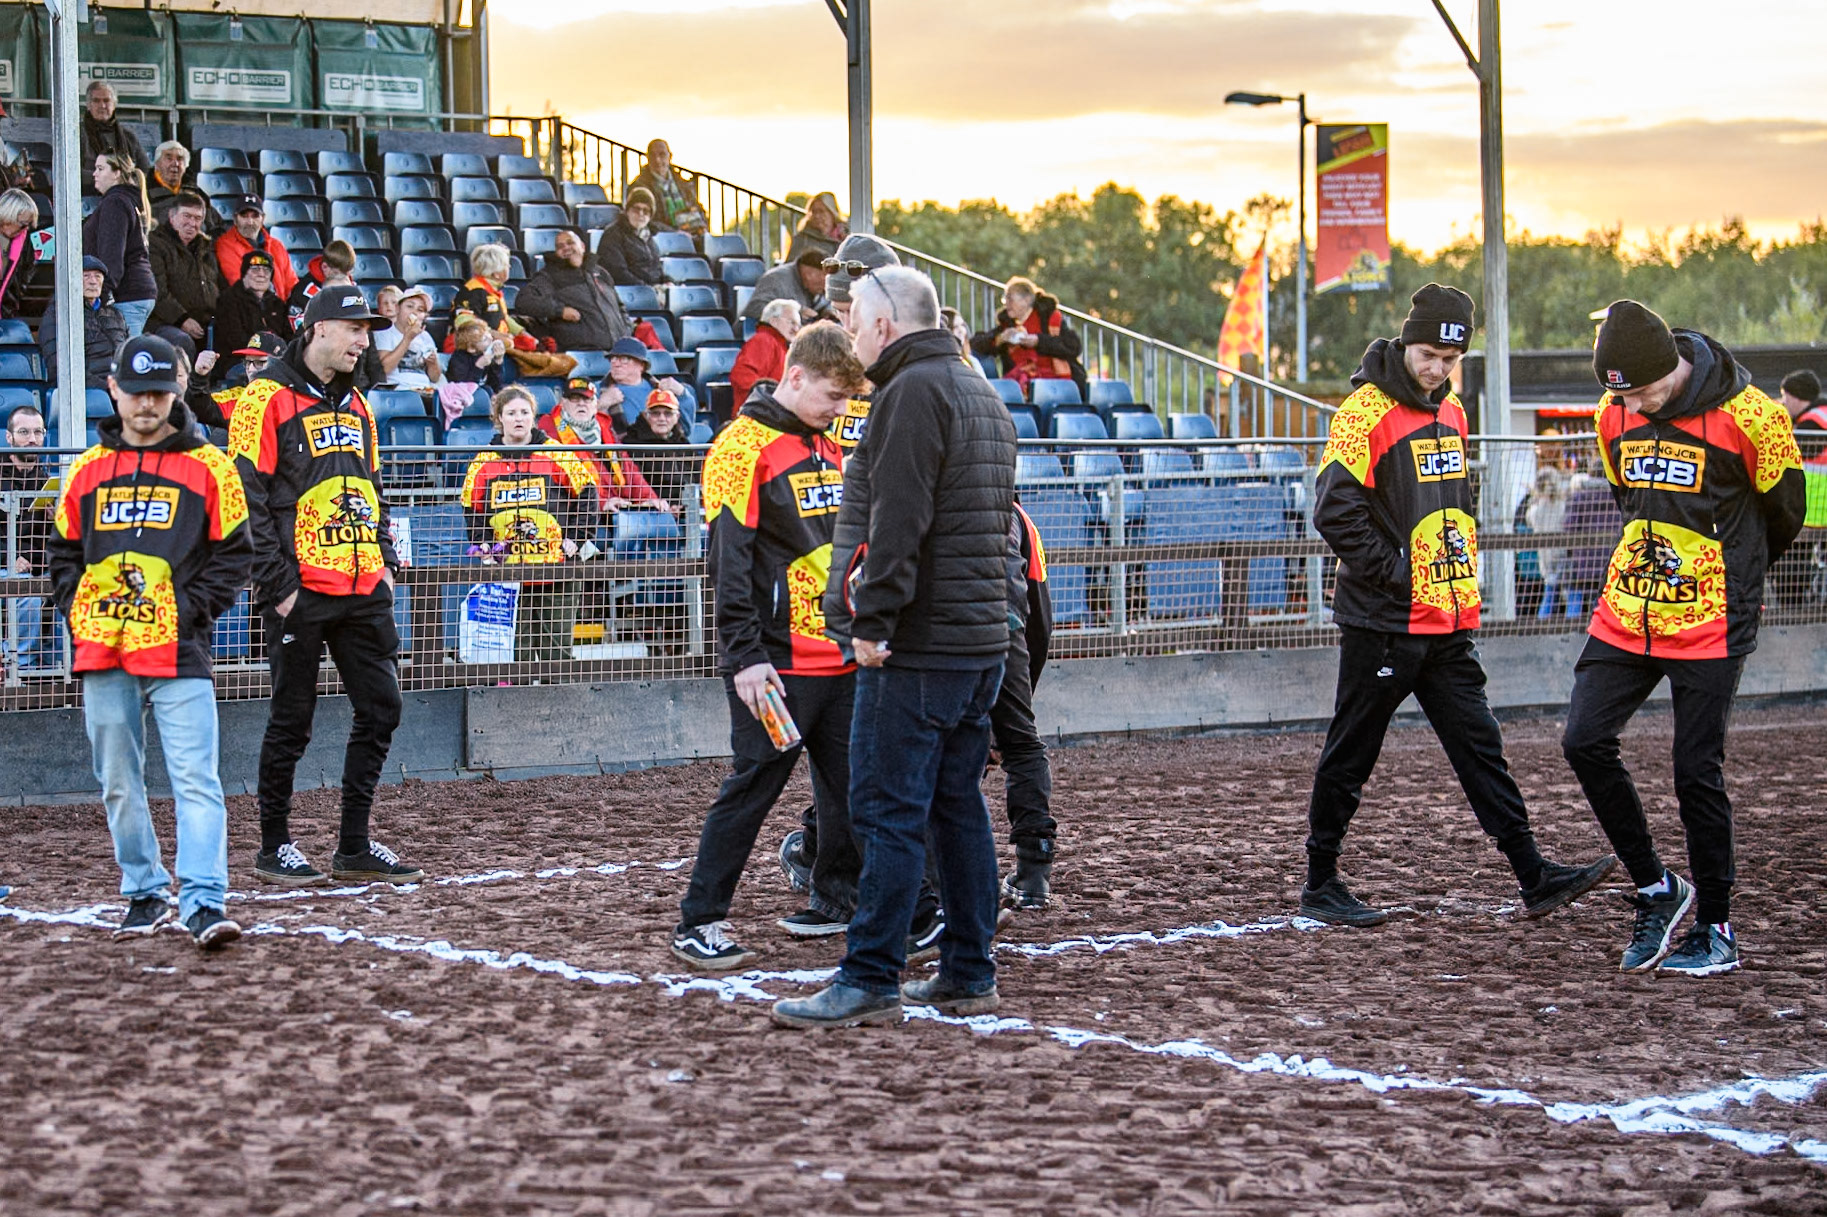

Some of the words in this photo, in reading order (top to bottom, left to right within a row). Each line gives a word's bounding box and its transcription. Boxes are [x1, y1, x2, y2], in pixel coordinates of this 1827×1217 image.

[107, 67, 153, 78] BARRIER
[194, 71, 241, 85] ECHO
[242, 74, 285, 87] BARRIER
[330, 77, 376, 91] ECHO
[377, 81, 418, 93] BARRIER
[314, 425, 362, 449] JCB
[1420, 450, 1462, 475] JCB
[1674, 448, 1697, 460] JCB
[1624, 457, 1696, 486] JCB
[495, 487, 542, 504] JCB
[102, 501, 170, 523] JCB
[318, 525, 378, 546] LION
[511, 541, 549, 555] ONS
[1430, 561, 1471, 583] LION
[1617, 575, 1696, 602] LIONS
